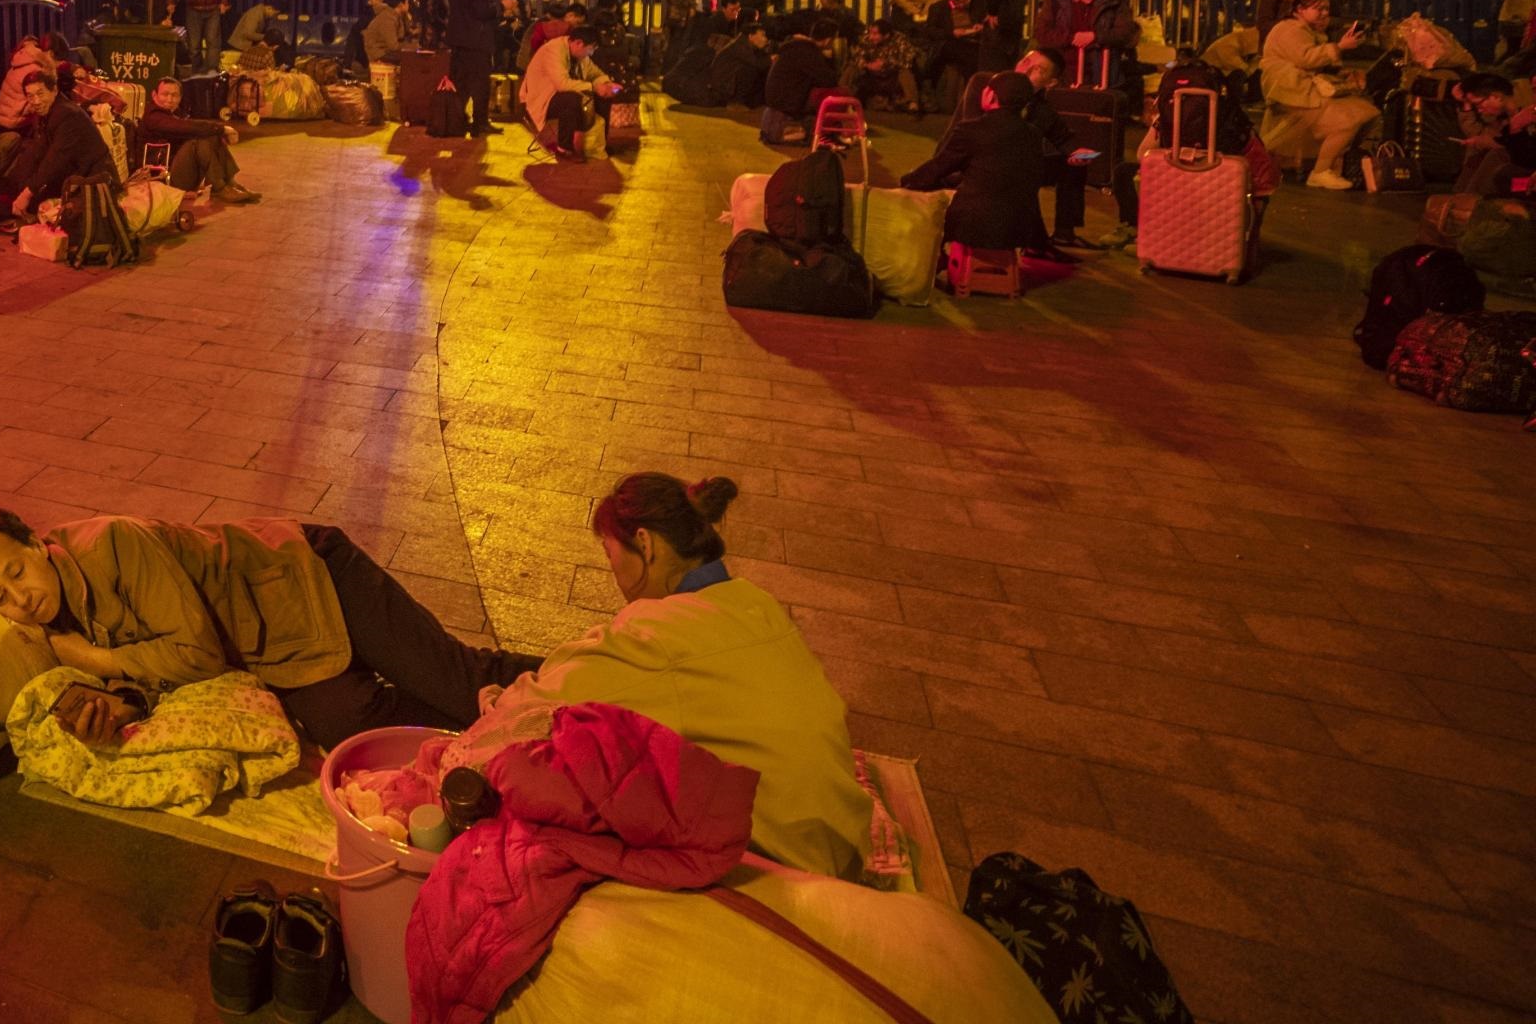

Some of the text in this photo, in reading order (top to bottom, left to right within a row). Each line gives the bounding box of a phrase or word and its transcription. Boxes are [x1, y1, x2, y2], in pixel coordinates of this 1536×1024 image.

[110, 50, 160, 67] 作业中心
[111, 65, 150, 80] YX 18
